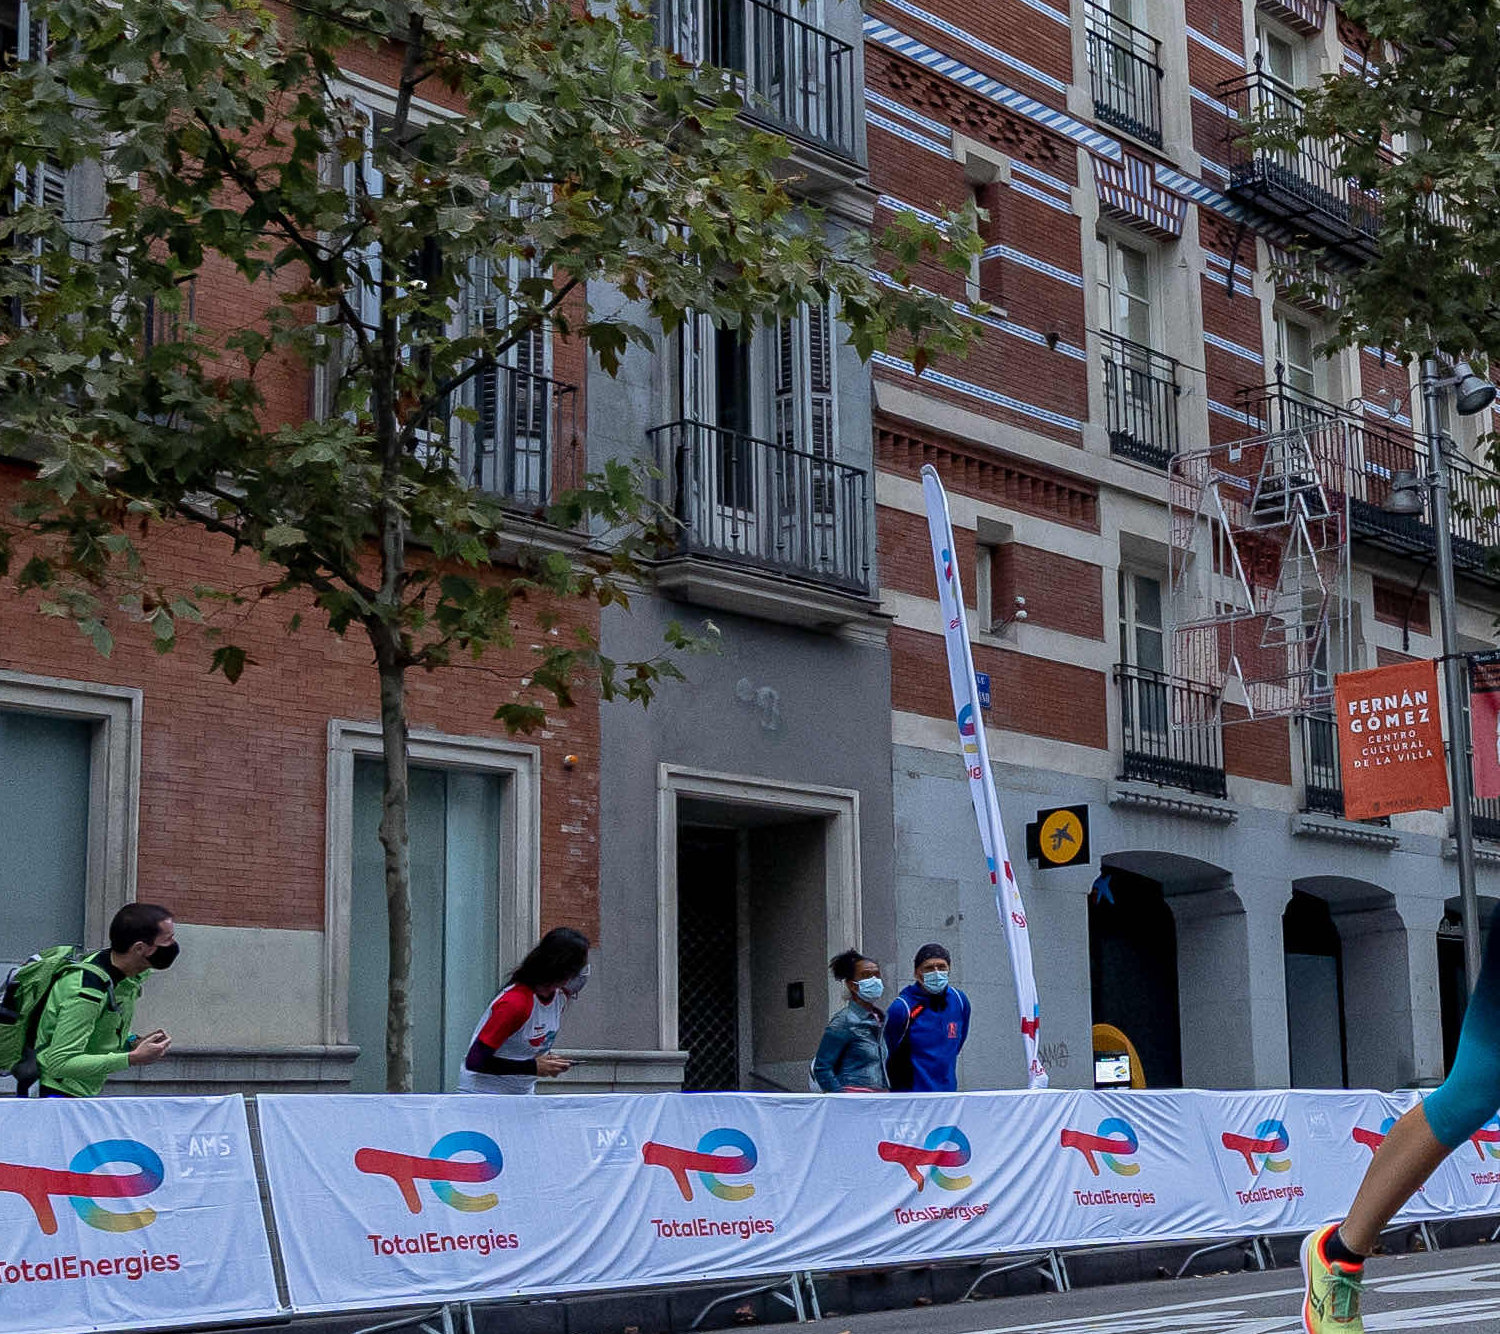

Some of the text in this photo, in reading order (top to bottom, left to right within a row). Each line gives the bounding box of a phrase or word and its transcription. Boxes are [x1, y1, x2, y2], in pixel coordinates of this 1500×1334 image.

[1348, 689, 1428, 715] FERNÁN
[1350, 709, 1429, 733] GÓMEZ
[1368, 730, 1416, 744] CENTRO
[1354, 749, 1433, 768] DE LA VILLA
[1362, 741, 1424, 756] CULTURAL
[188, 1135, 231, 1156] AMS
[1073, 1189, 1155, 1208] TotalEnergies
[651, 1214, 775, 1240] TotalEnergies
[367, 1229, 520, 1257] TotalEnergies
